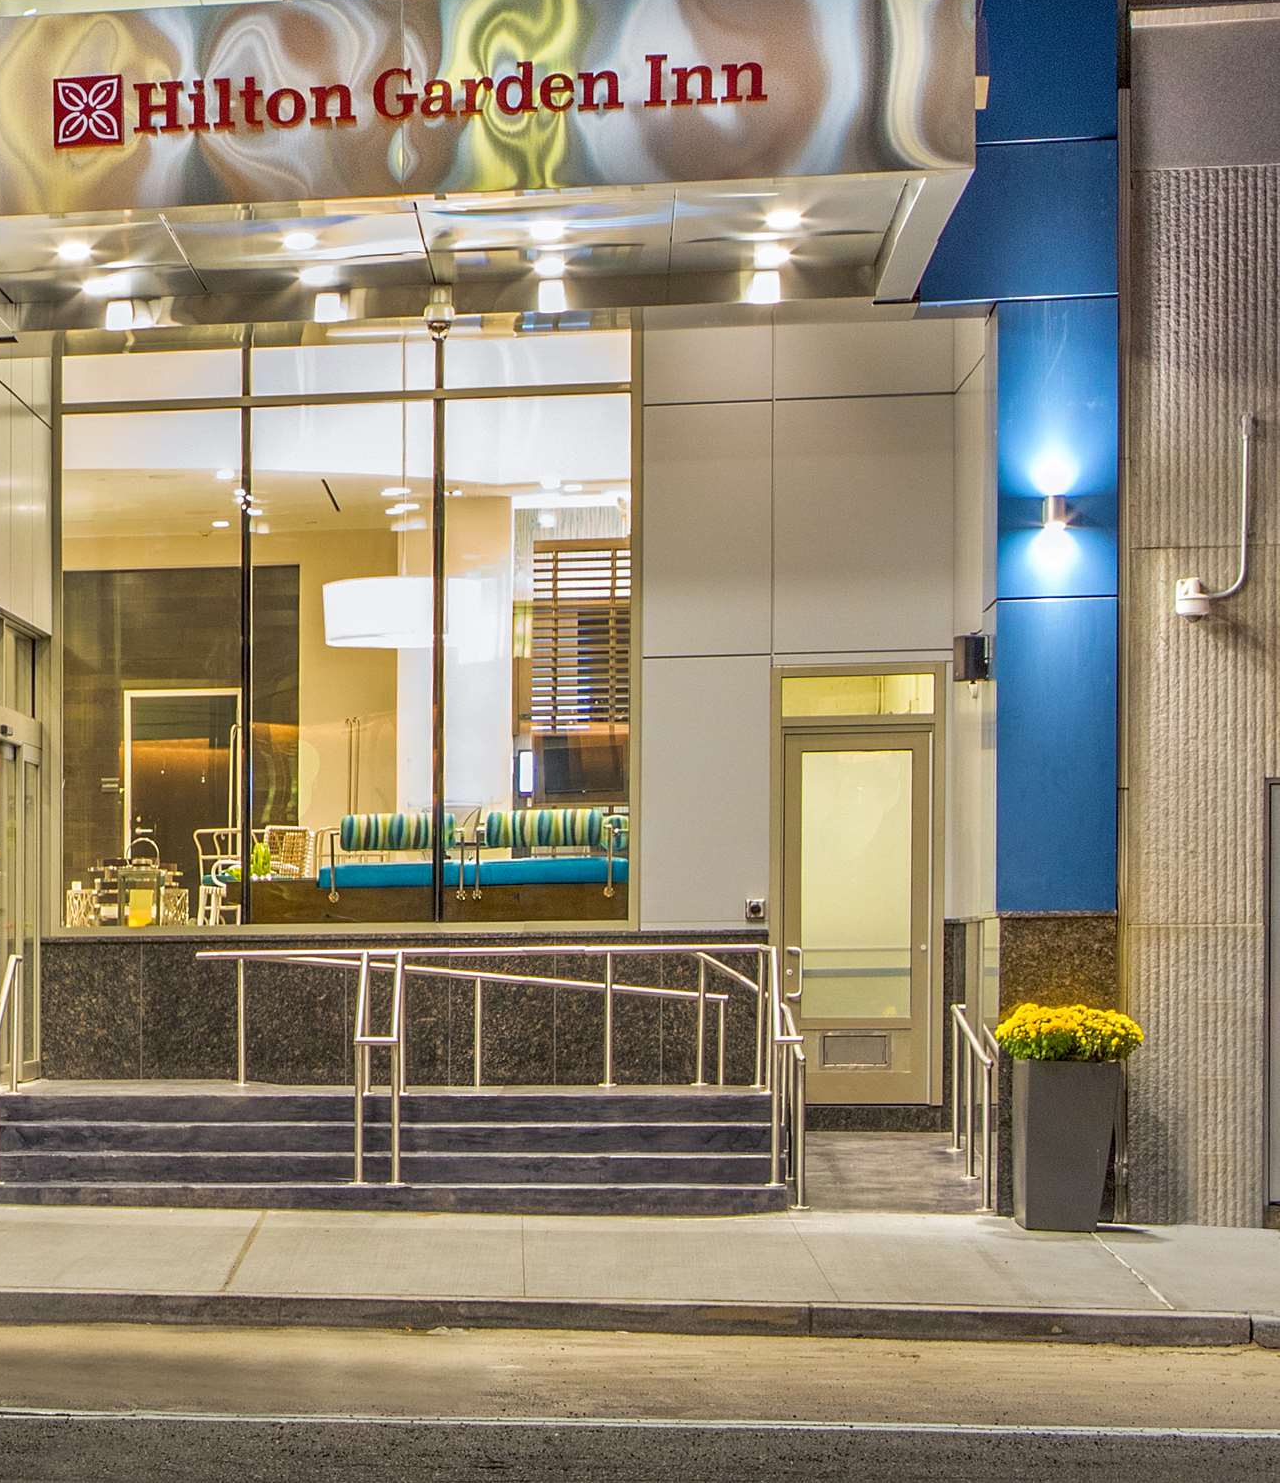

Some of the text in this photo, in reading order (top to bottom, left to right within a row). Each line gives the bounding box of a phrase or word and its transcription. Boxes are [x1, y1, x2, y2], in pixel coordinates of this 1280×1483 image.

[132, 53, 768, 136] Hilton Garden Inn
